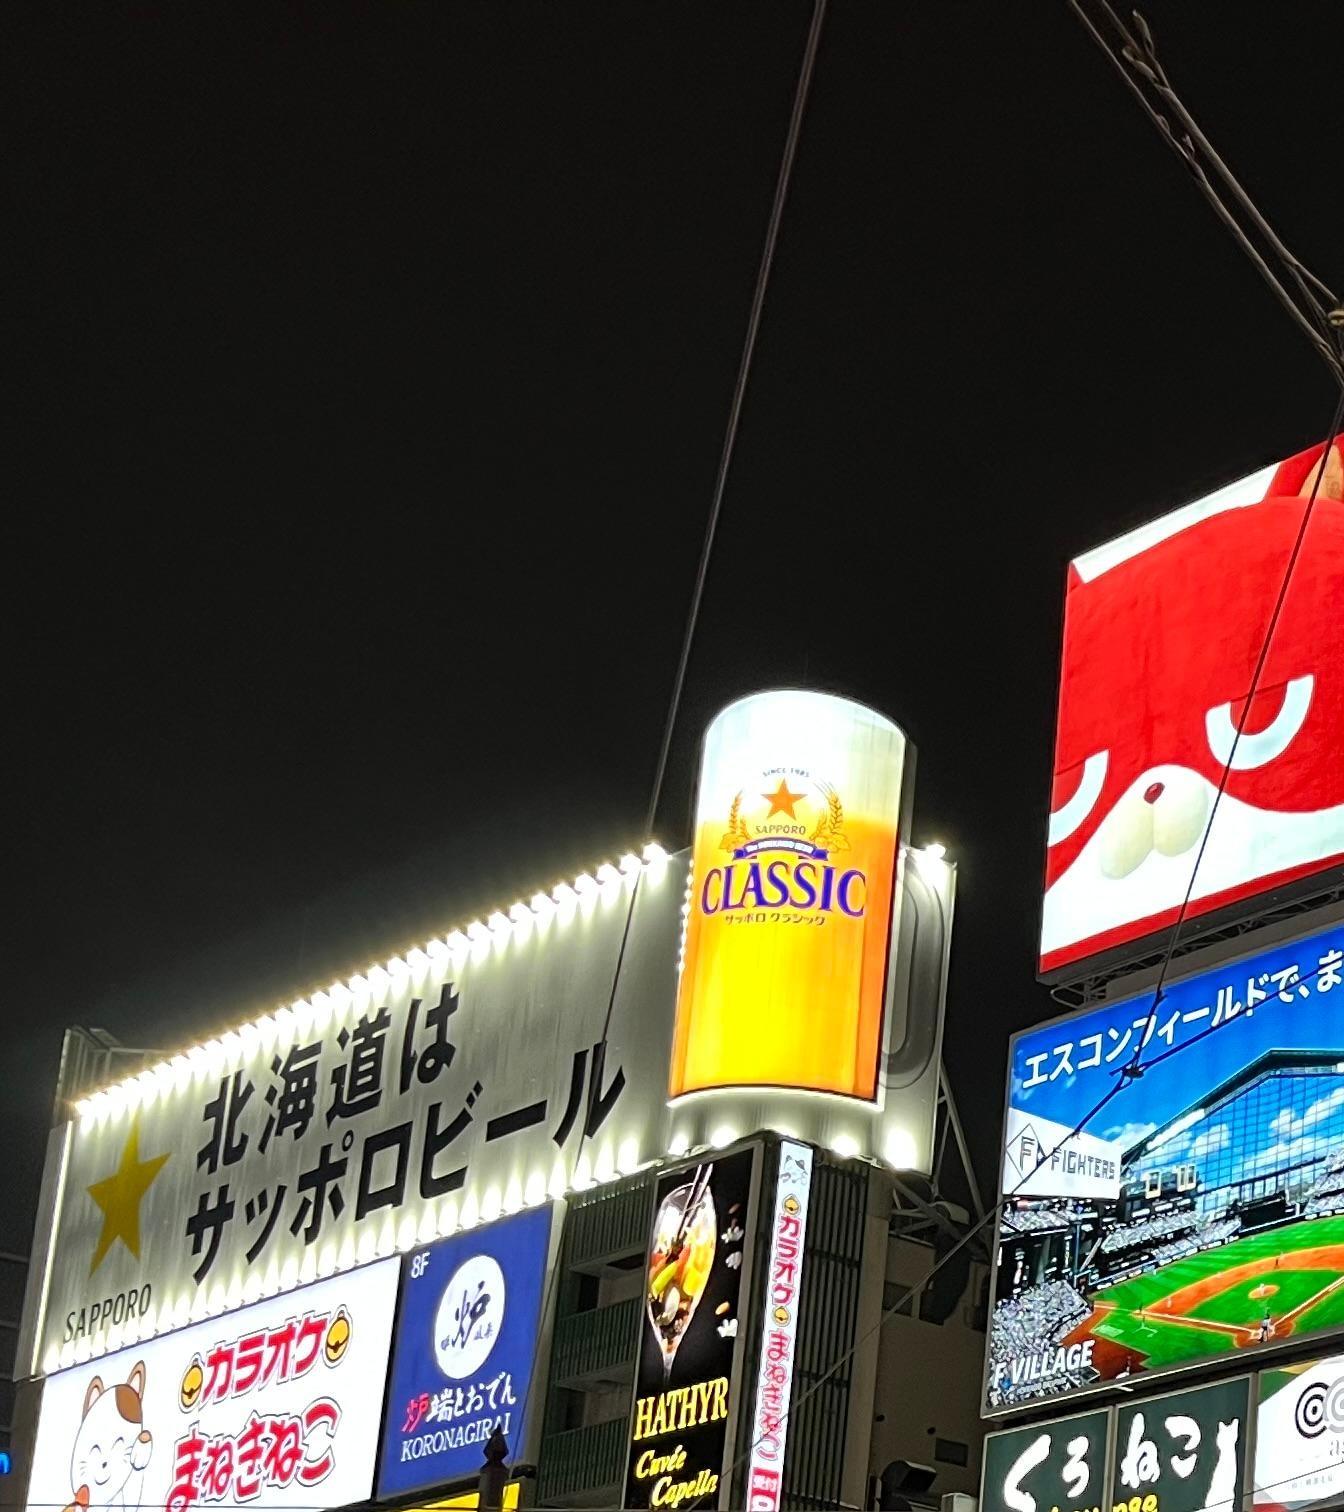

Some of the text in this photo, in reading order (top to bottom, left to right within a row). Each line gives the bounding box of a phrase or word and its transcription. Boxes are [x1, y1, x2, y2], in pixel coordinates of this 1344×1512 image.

[755, 824, 807, 835] SAPPORO
[702, 860, 866, 917] CLASSIC
[196, 983, 461, 1175] 北海道は
[185, 1041, 626, 1285] サッポロビール
[1051, 1147, 1116, 1181] FIGHTERS
[411, 1252, 431, 1278] 8F
[770, 1214, 801, 1306] カラオケ
[63, 1284, 152, 1343] SAPPORO
[204, 1311, 329, 1400] カラオケ
[1010, 1341, 1095, 1386] VILLAGE
[634, 1377, 729, 1441] HATHYR
[752, 1328, 791, 1460] まねきねこ
[636, 1445, 688, 1479] Cuvée
[651, 1470, 719, 1509] Capella
